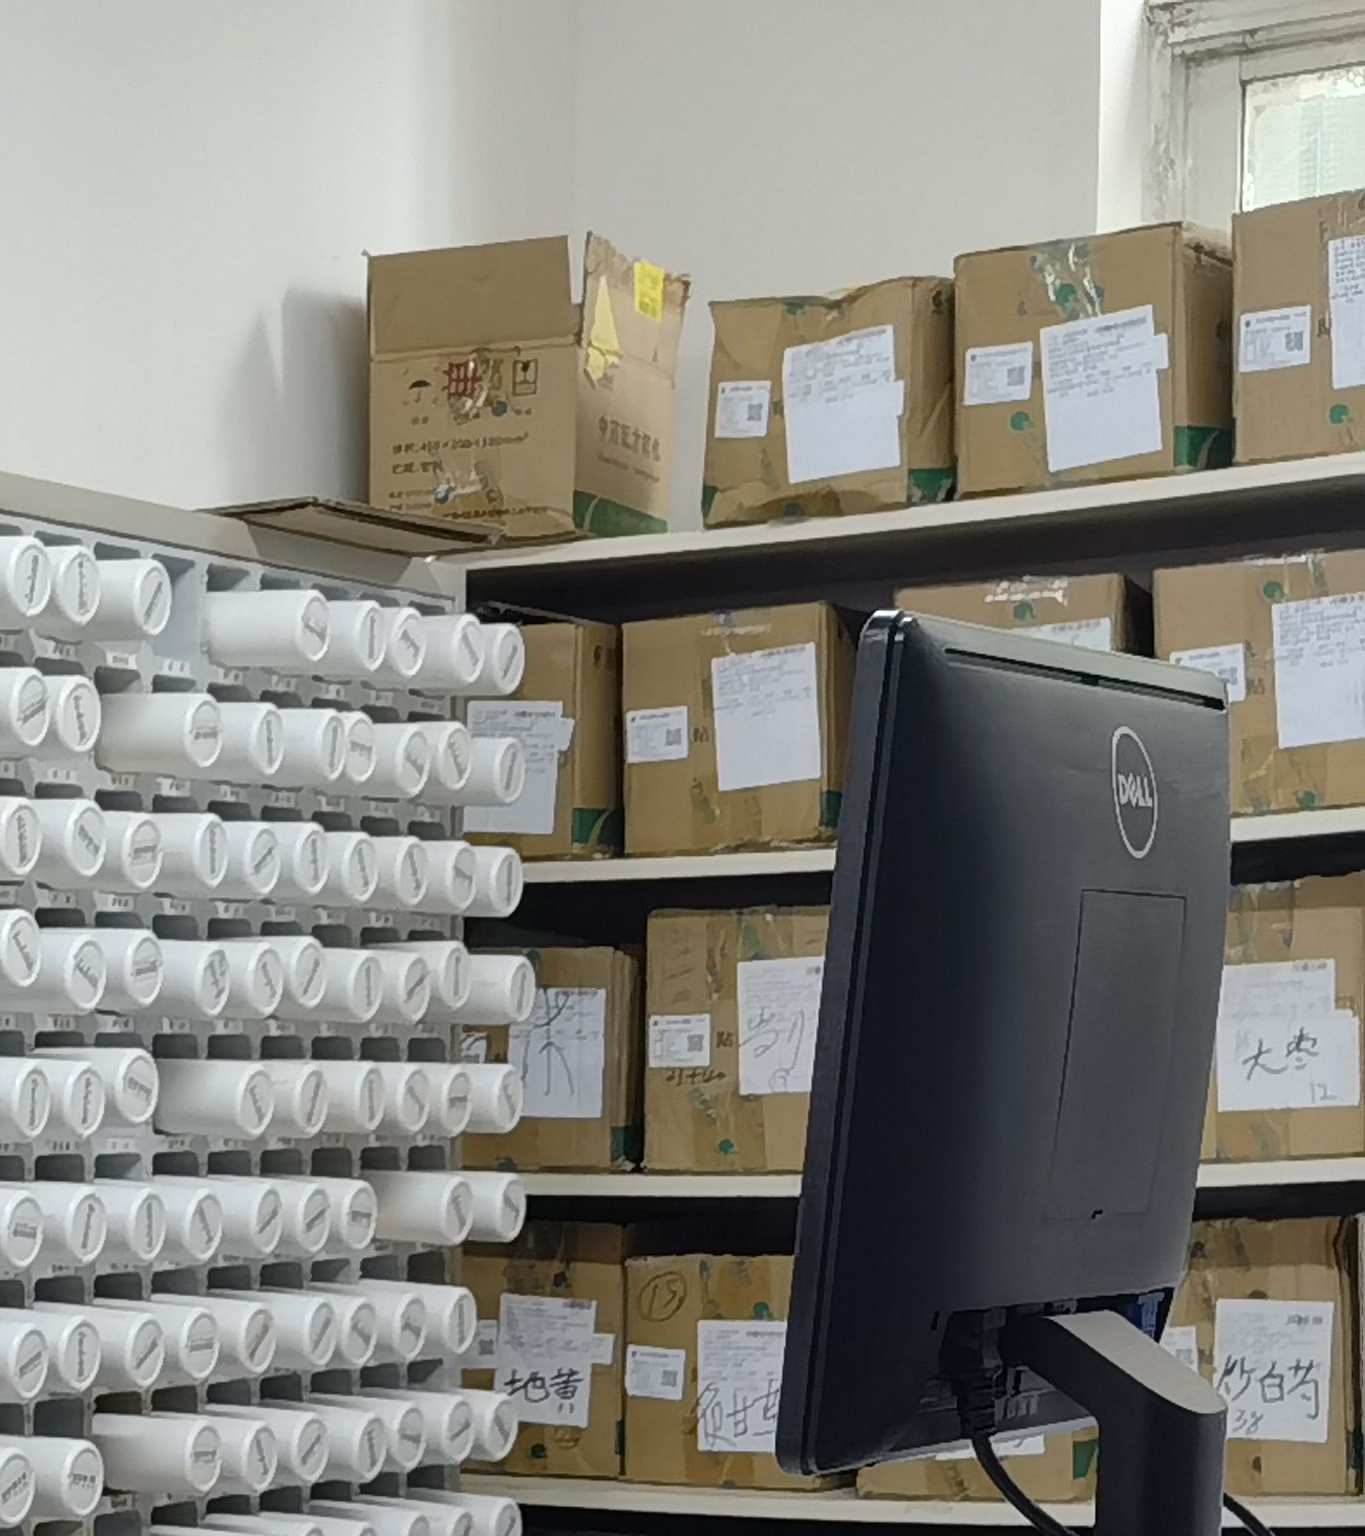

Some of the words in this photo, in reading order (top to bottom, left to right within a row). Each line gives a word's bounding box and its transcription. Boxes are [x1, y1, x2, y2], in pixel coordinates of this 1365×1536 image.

[1117, 772, 1153, 807] DELL
[503, 1347, 585, 1414] 地黄
[1216, 1353, 1320, 1421] 炒白芍
